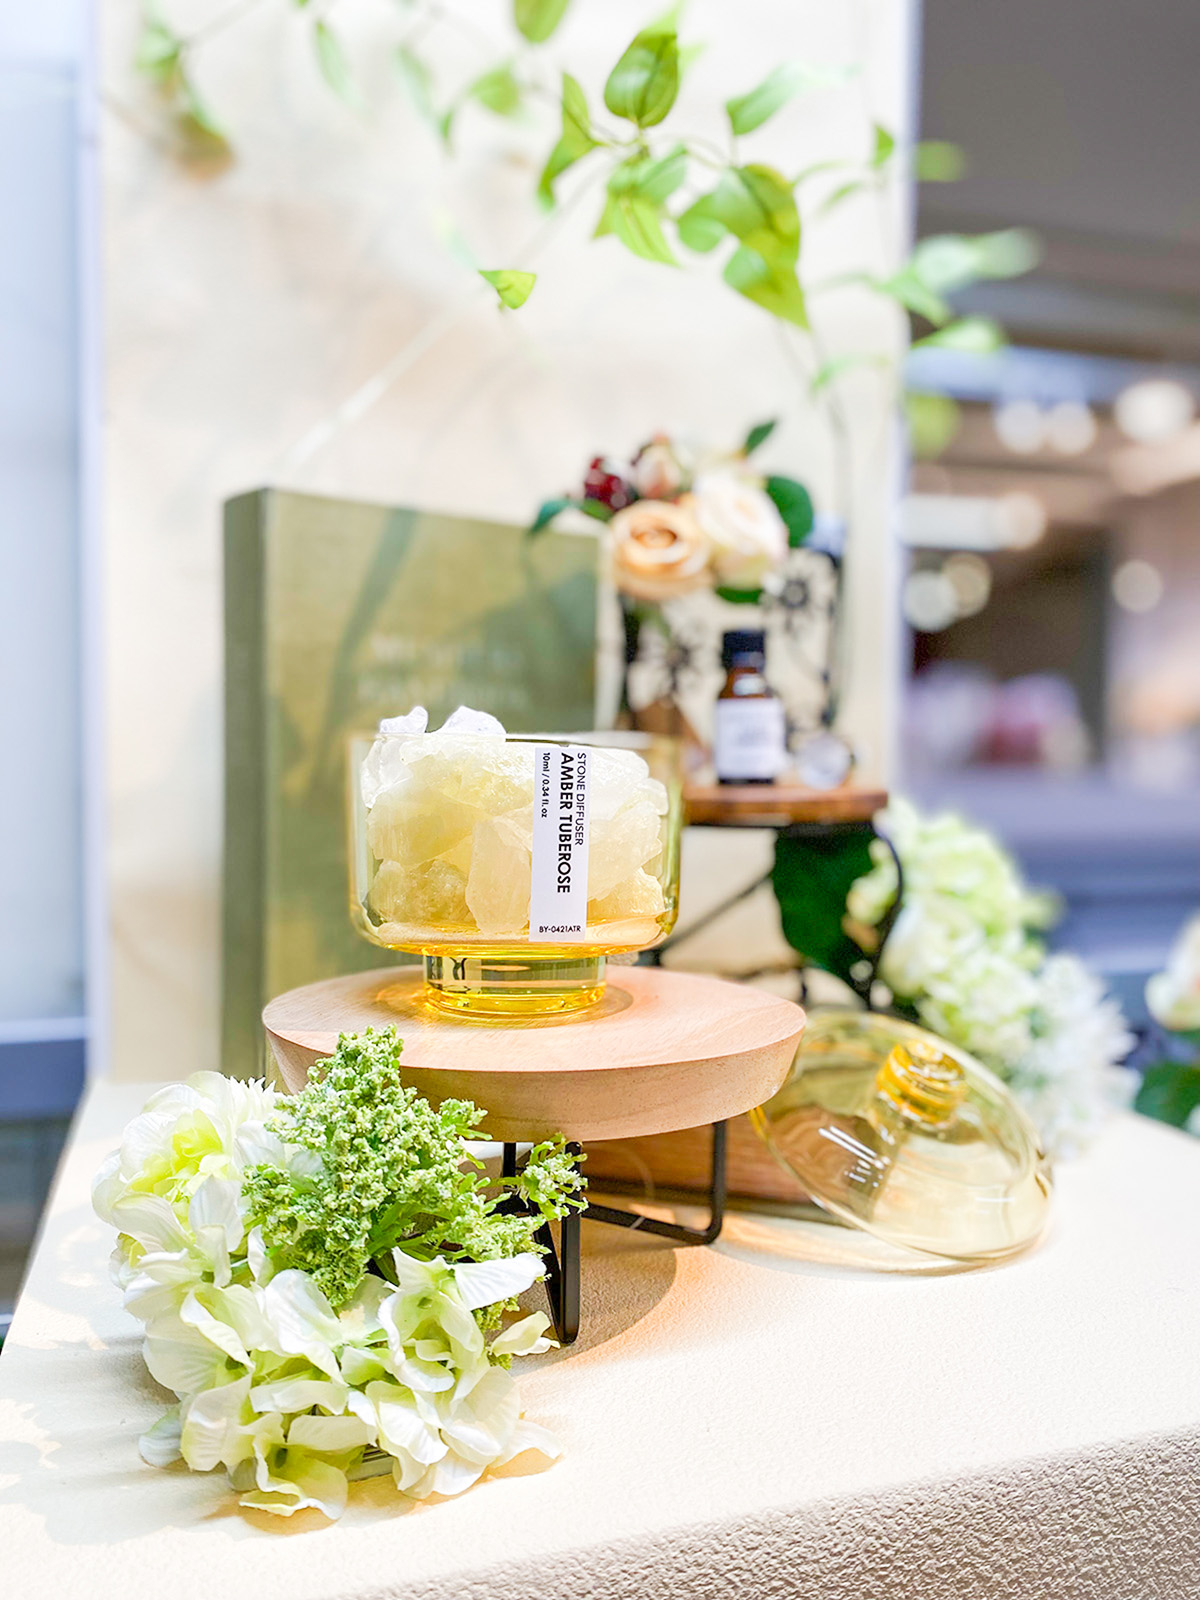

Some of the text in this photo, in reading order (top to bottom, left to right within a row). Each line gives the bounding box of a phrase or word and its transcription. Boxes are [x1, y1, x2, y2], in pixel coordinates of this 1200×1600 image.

[542, 752, 551, 772] 10ml
[541, 779, 550, 797] 0.34
[574, 752, 587, 846] STONE DIFFUSER
[557, 752, 575, 893] AMBER TUBEROSE
[539, 925, 581, 933] BY-0421ATR
